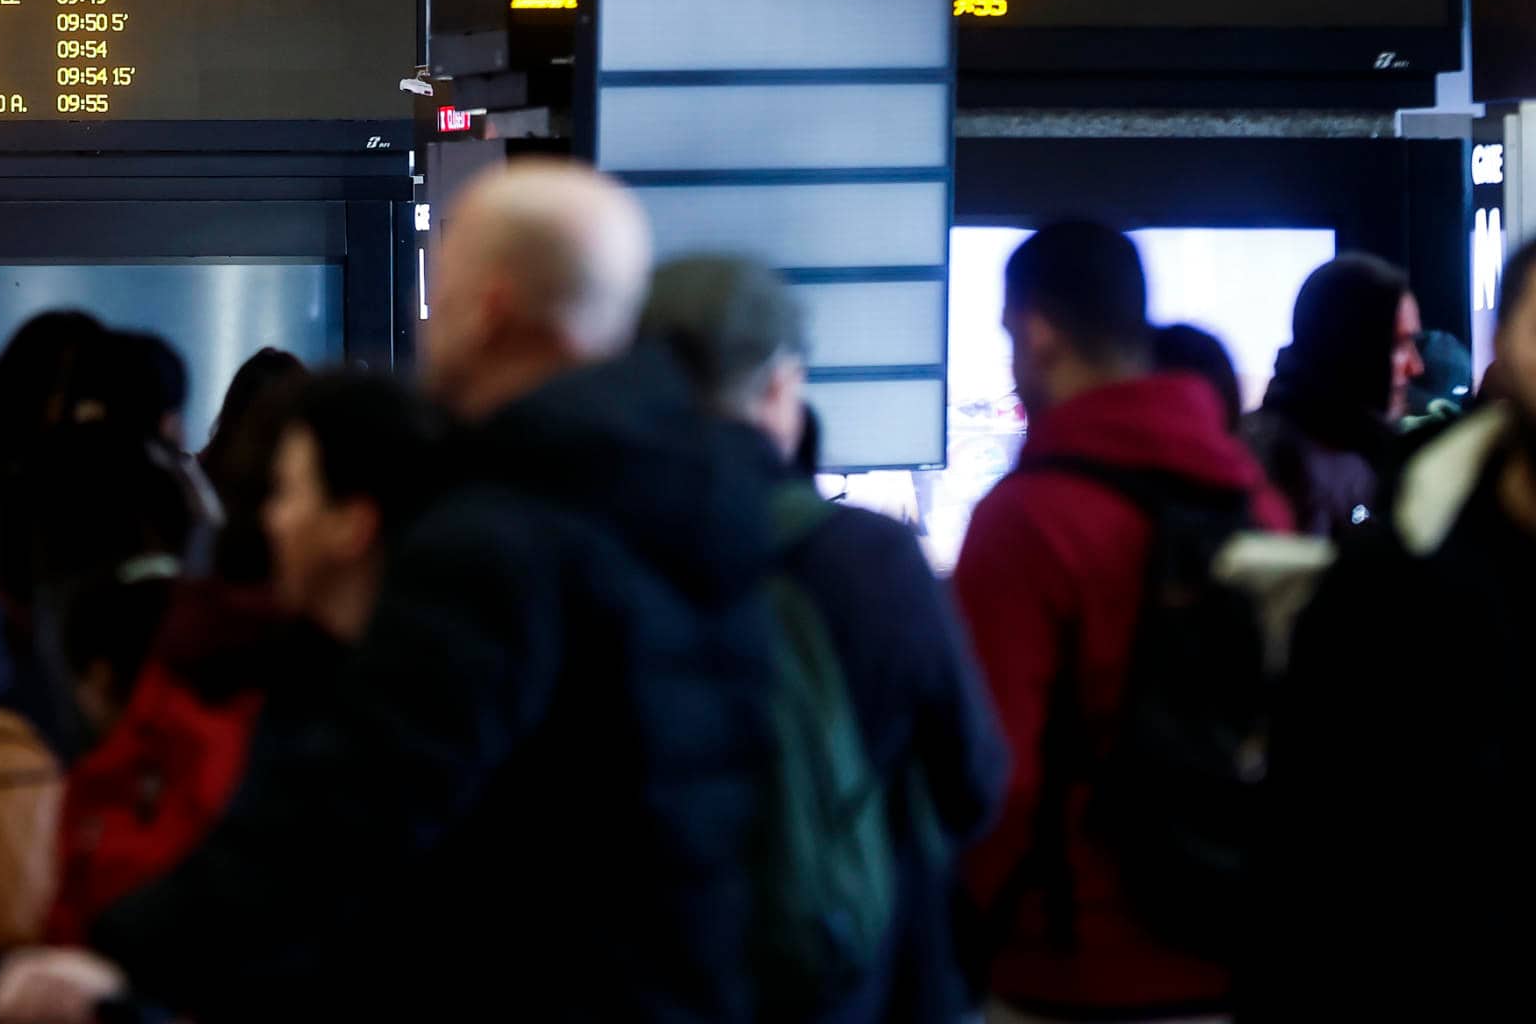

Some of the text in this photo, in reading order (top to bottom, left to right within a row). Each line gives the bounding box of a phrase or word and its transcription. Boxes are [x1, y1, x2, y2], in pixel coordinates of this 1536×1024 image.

[56, 13, 108, 32] 09:50
[57, 39, 108, 59] 09:54
[56, 66, 108, 86] 09:54
[10, 94, 28, 113] A.
[57, 93, 109, 113] 09:55
